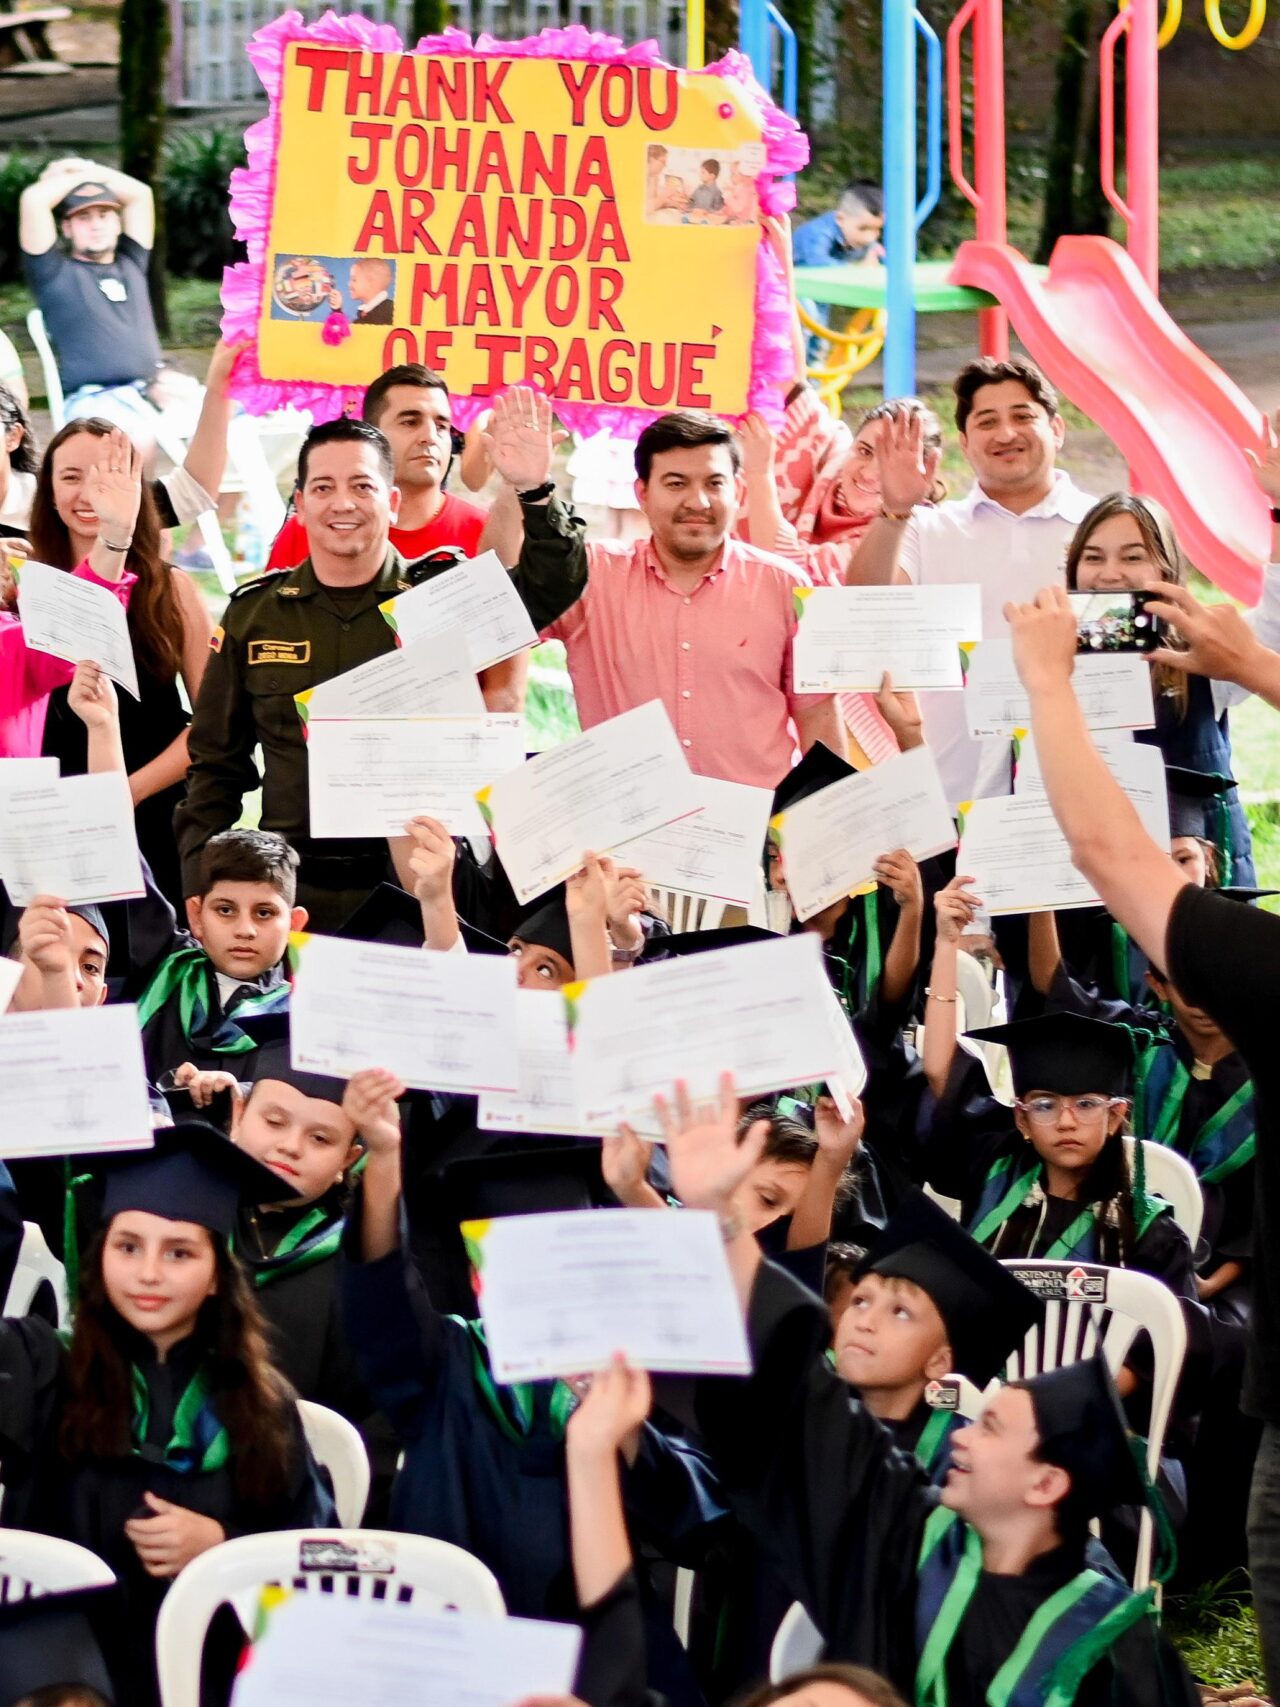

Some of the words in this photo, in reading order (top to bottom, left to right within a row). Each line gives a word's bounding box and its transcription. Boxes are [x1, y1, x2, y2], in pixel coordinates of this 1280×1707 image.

[296, 48, 514, 123] THANK
[558, 62, 679, 131] YOU
[347, 121, 616, 199] JOHANA
[354, 188, 630, 262] ARANDA
[410, 262, 625, 332] MAYOR
[383, 328, 453, 373] OF
[1010, 1270, 1063, 1279] ESISTENCIA
